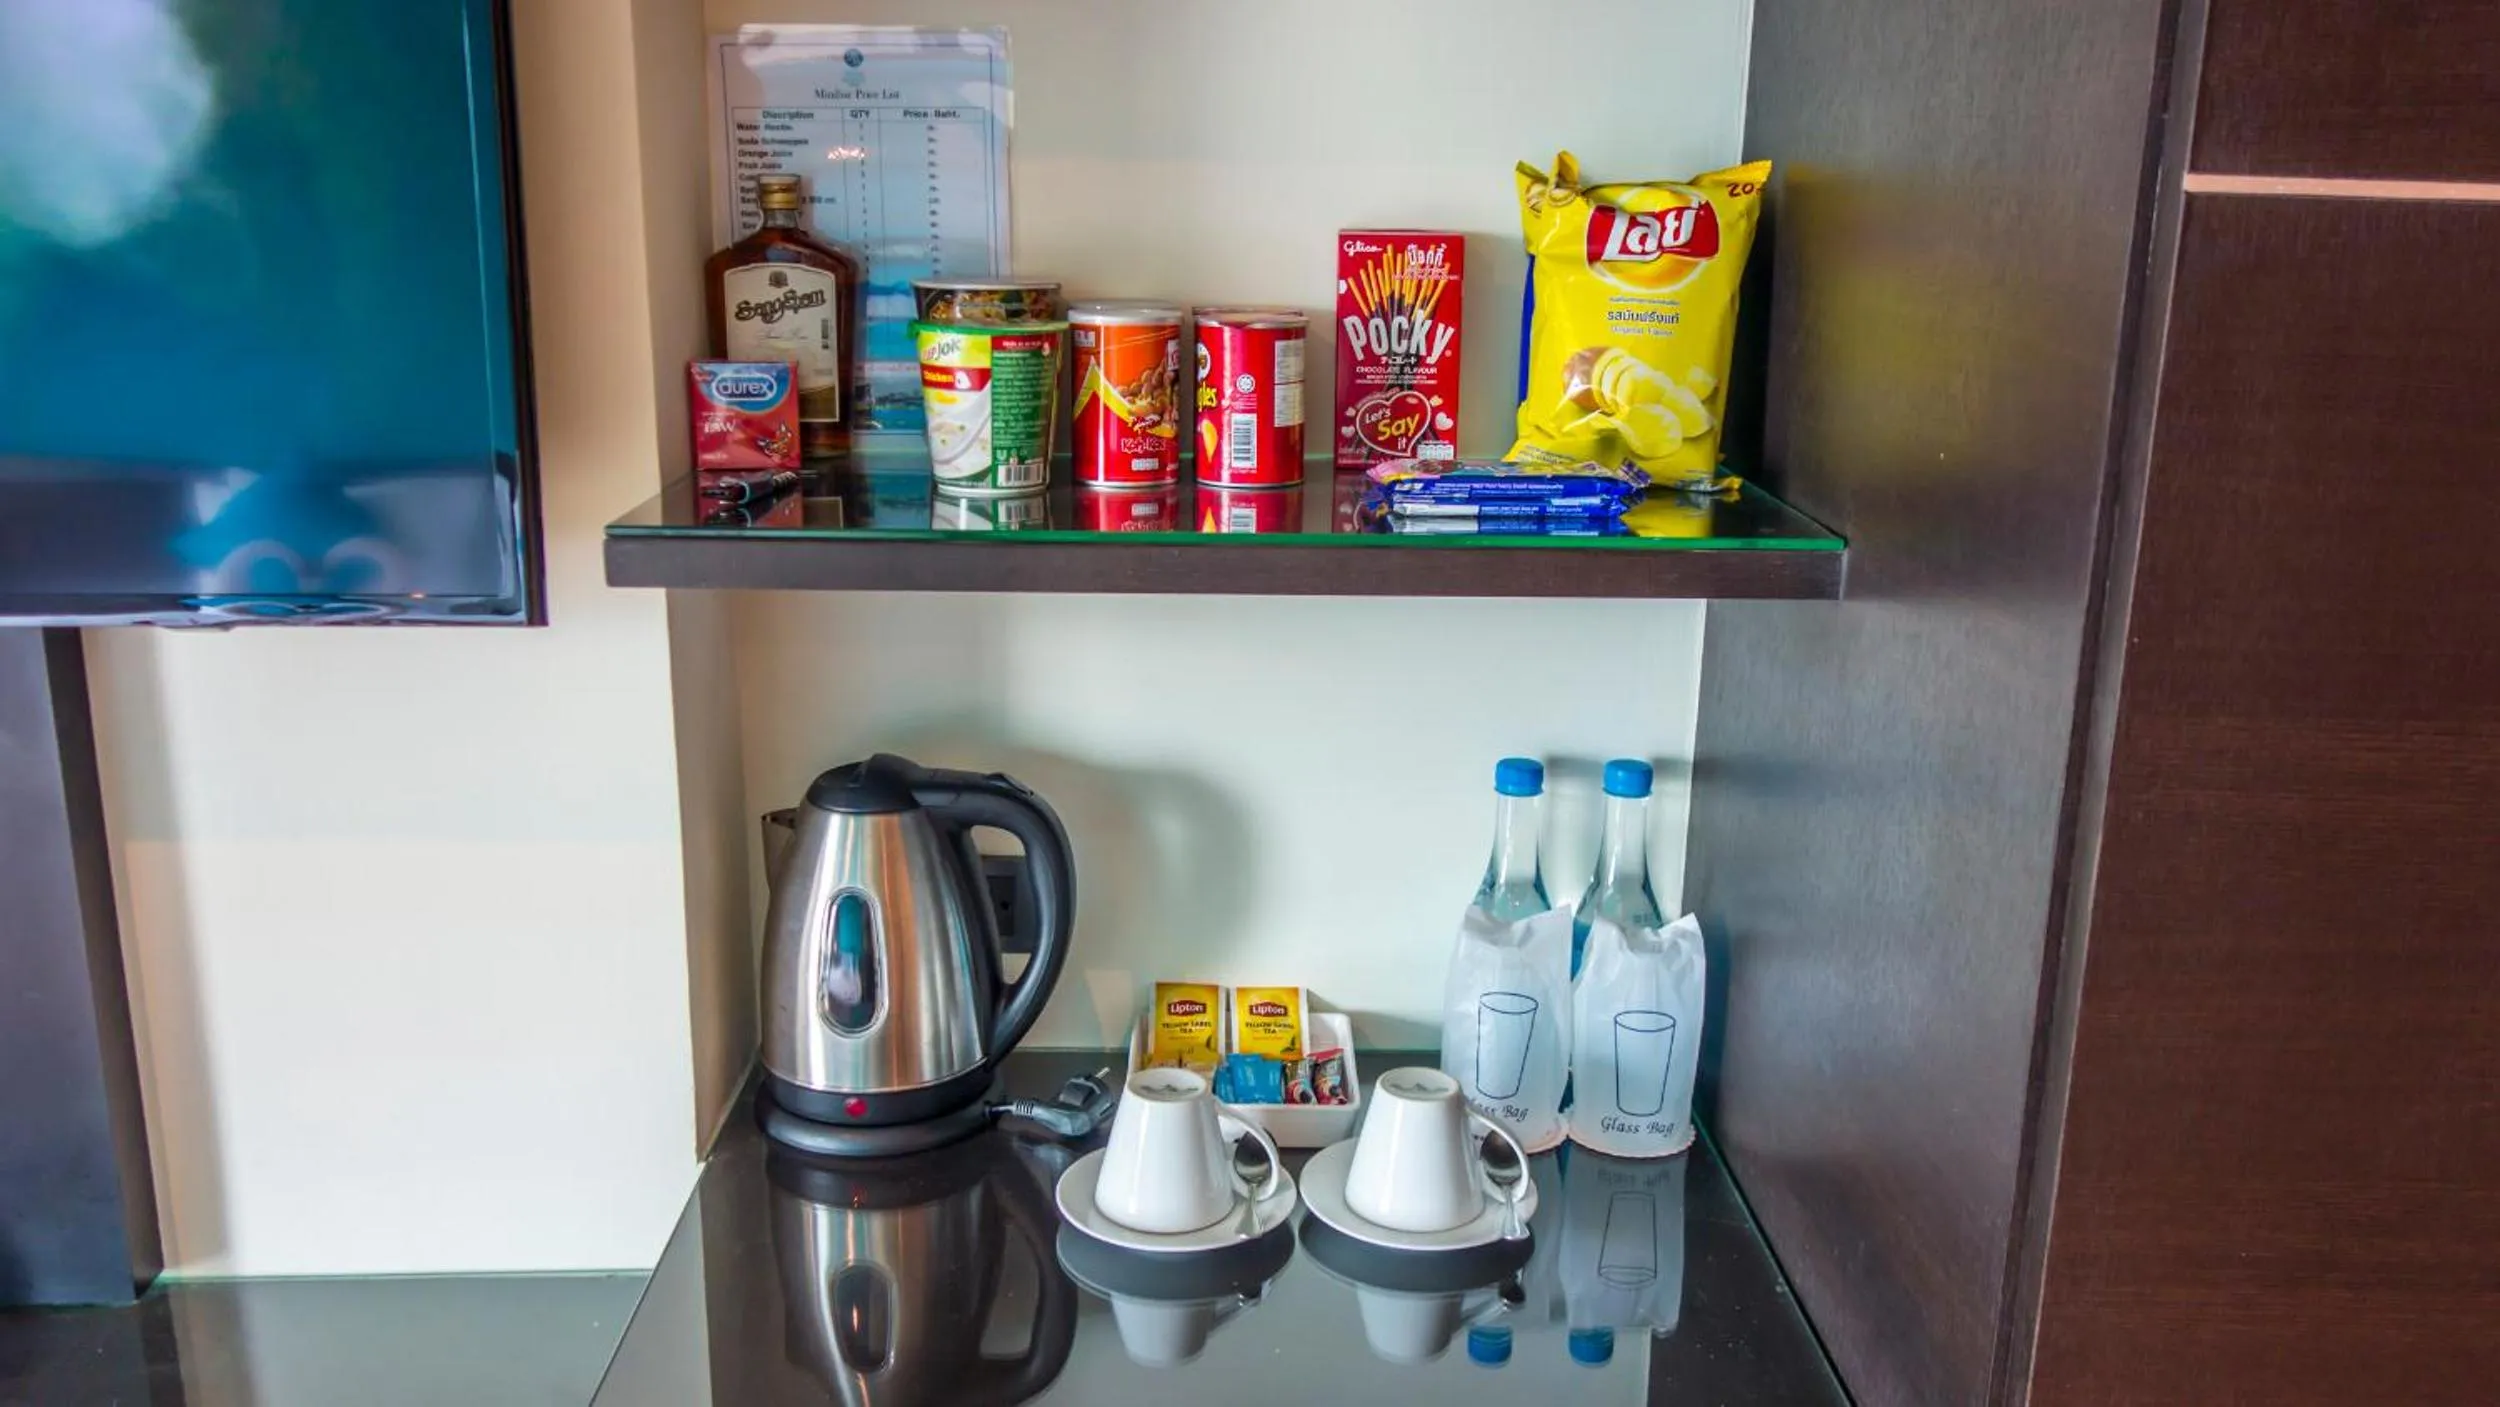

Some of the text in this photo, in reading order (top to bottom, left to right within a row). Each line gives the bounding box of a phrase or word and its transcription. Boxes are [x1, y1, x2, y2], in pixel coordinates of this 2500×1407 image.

[855, 88, 879, 100] Price
[882, 88, 900, 100] List
[849, 109, 870, 119] QTY
[903, 109, 929, 119] Price
[1343, 240, 1383, 258] Glico
[1343, 308, 1456, 365] POCKY
[1355, 366, 1438, 375] CHOCOLATE FLAVOUR
[719, 382, 775, 398] durex
[1364, 407, 1392, 425] Let's
[1377, 412, 1420, 441] Say
[1397, 436, 1407, 450] it
[1170, 1001, 1204, 1014] Lipton
[1252, 1004, 1286, 1016] Lipton
[1162, 1020, 1212, 1029] YELLOW LABEL
[1245, 1021, 1295, 1030] YELLOW LABEL
[1263, 1027, 1277, 1035] TEA
[1502, 1104, 1529, 1122] Bag
[1600, 1115, 1675, 1138] Glass Bag
